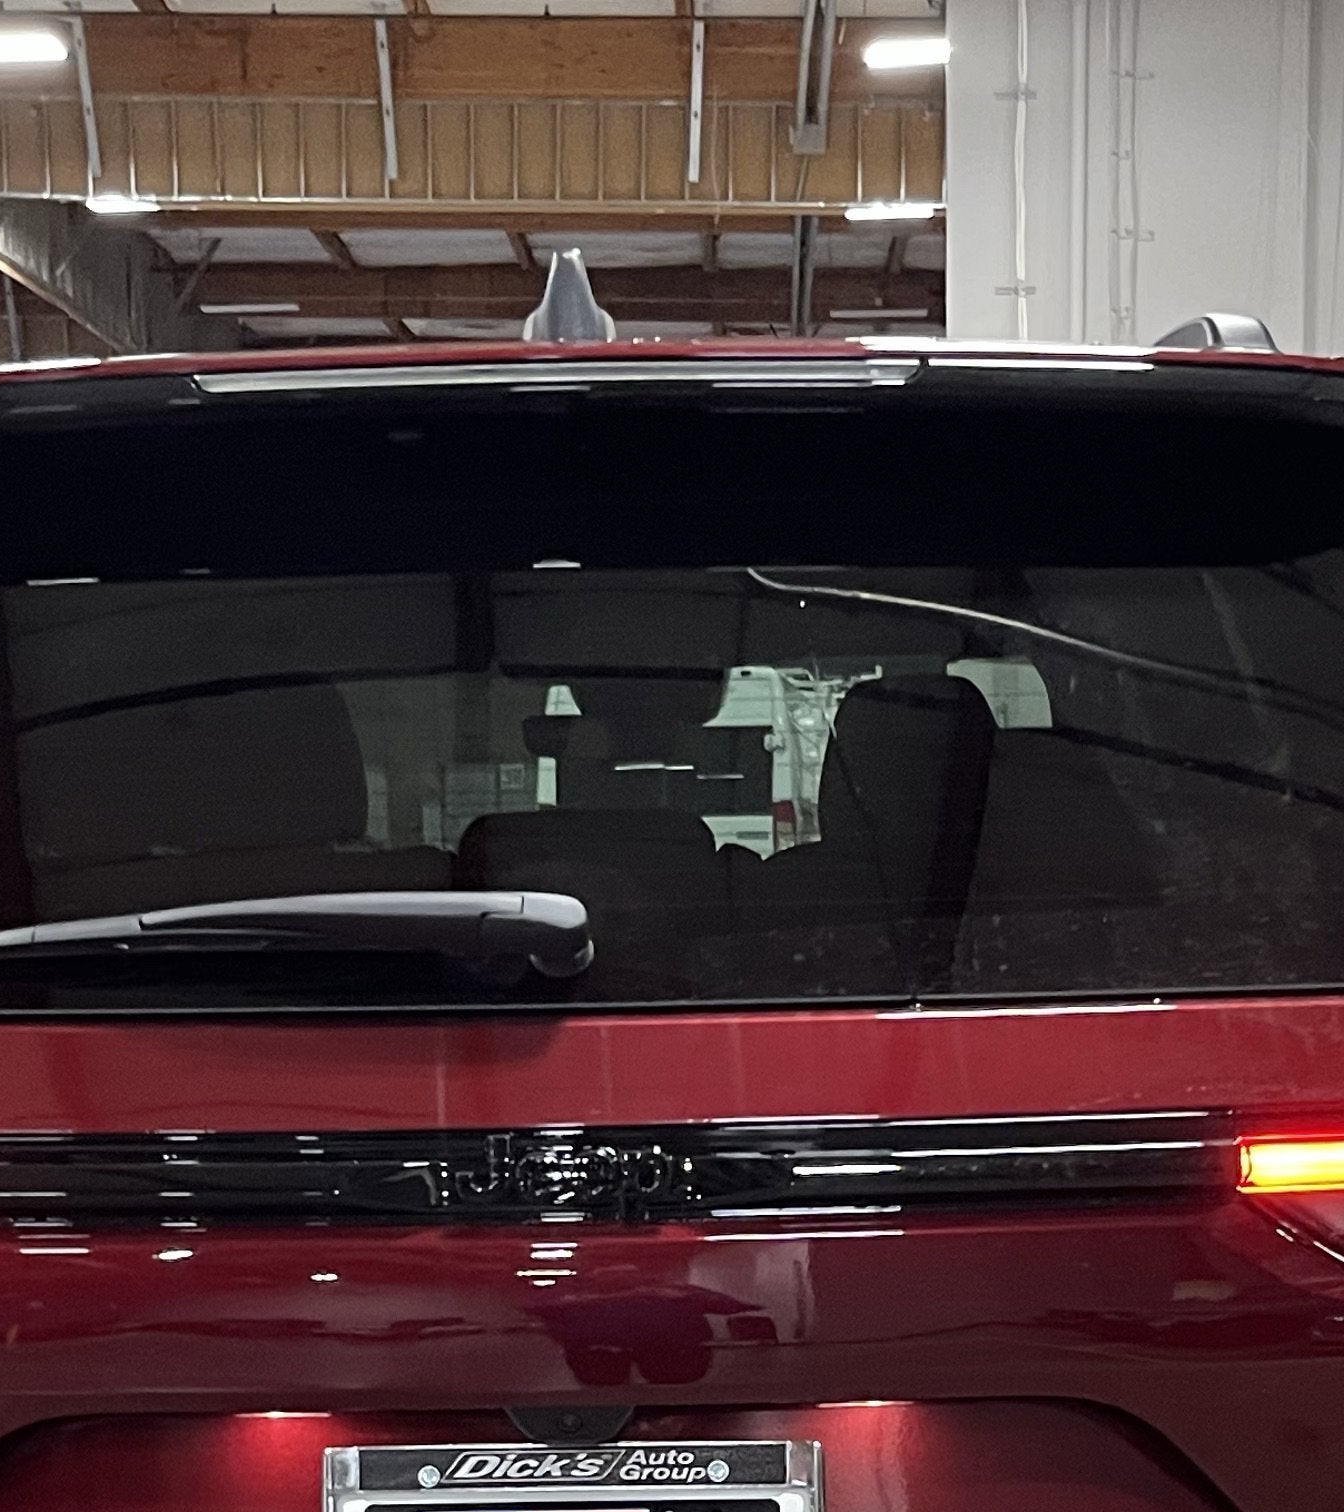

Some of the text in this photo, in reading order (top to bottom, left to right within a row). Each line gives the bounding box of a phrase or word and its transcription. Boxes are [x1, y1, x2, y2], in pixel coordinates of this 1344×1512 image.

[452, 1452, 606, 1480] Dick's
[626, 1449, 695, 1466] Auto
[619, 1464, 707, 1483] Group
